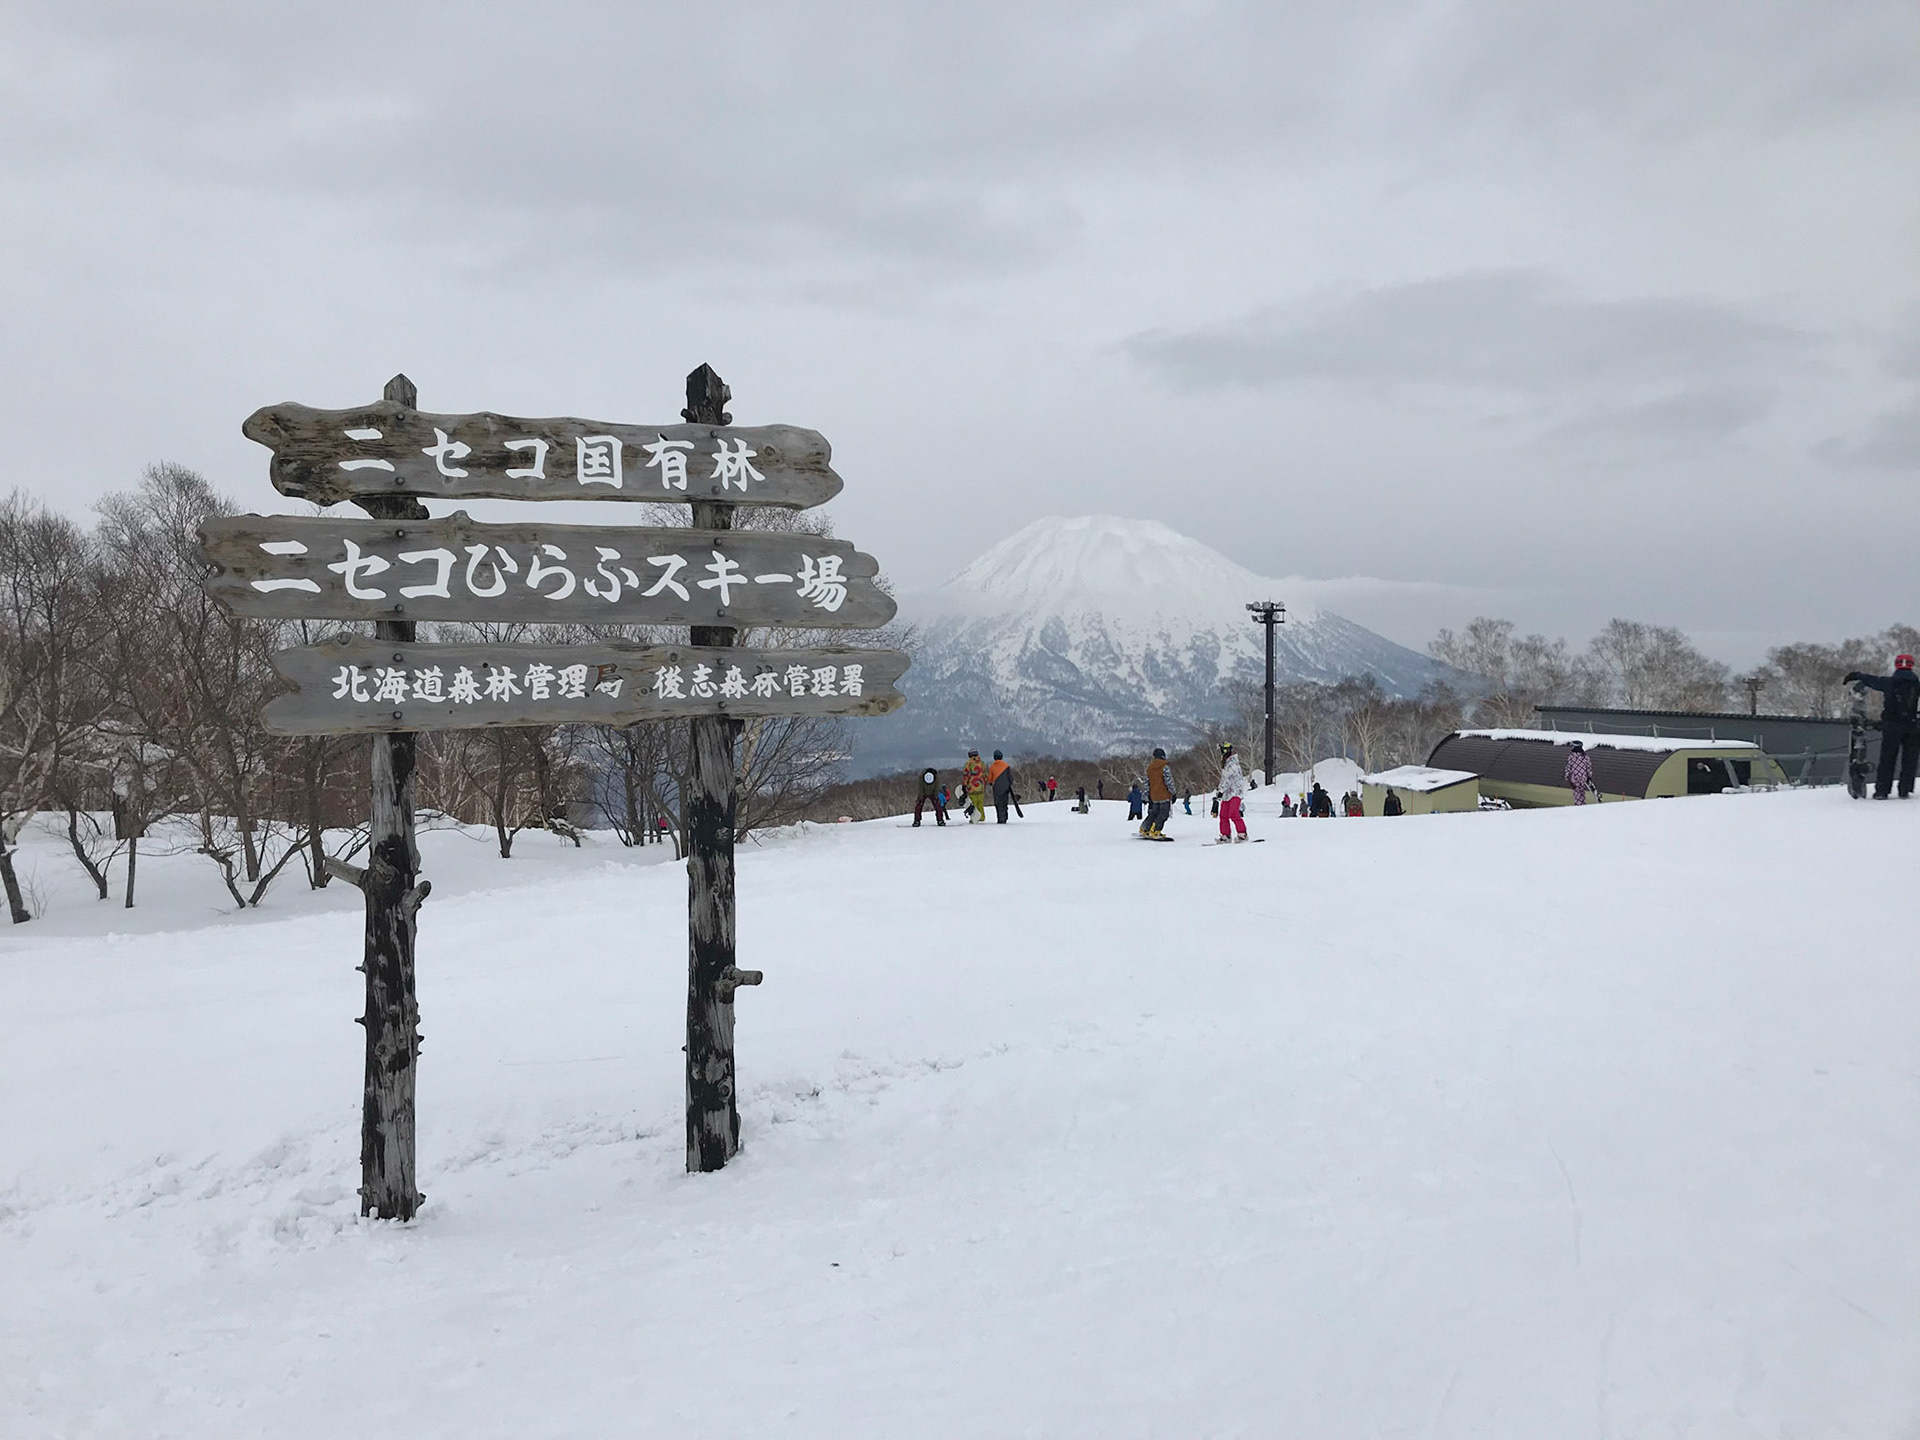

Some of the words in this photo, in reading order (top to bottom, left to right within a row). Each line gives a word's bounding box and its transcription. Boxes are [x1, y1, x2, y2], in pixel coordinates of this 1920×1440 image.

[338, 427, 766, 492] ニセコ国有林
[250, 538, 848, 612] ニセコひらふスキー場
